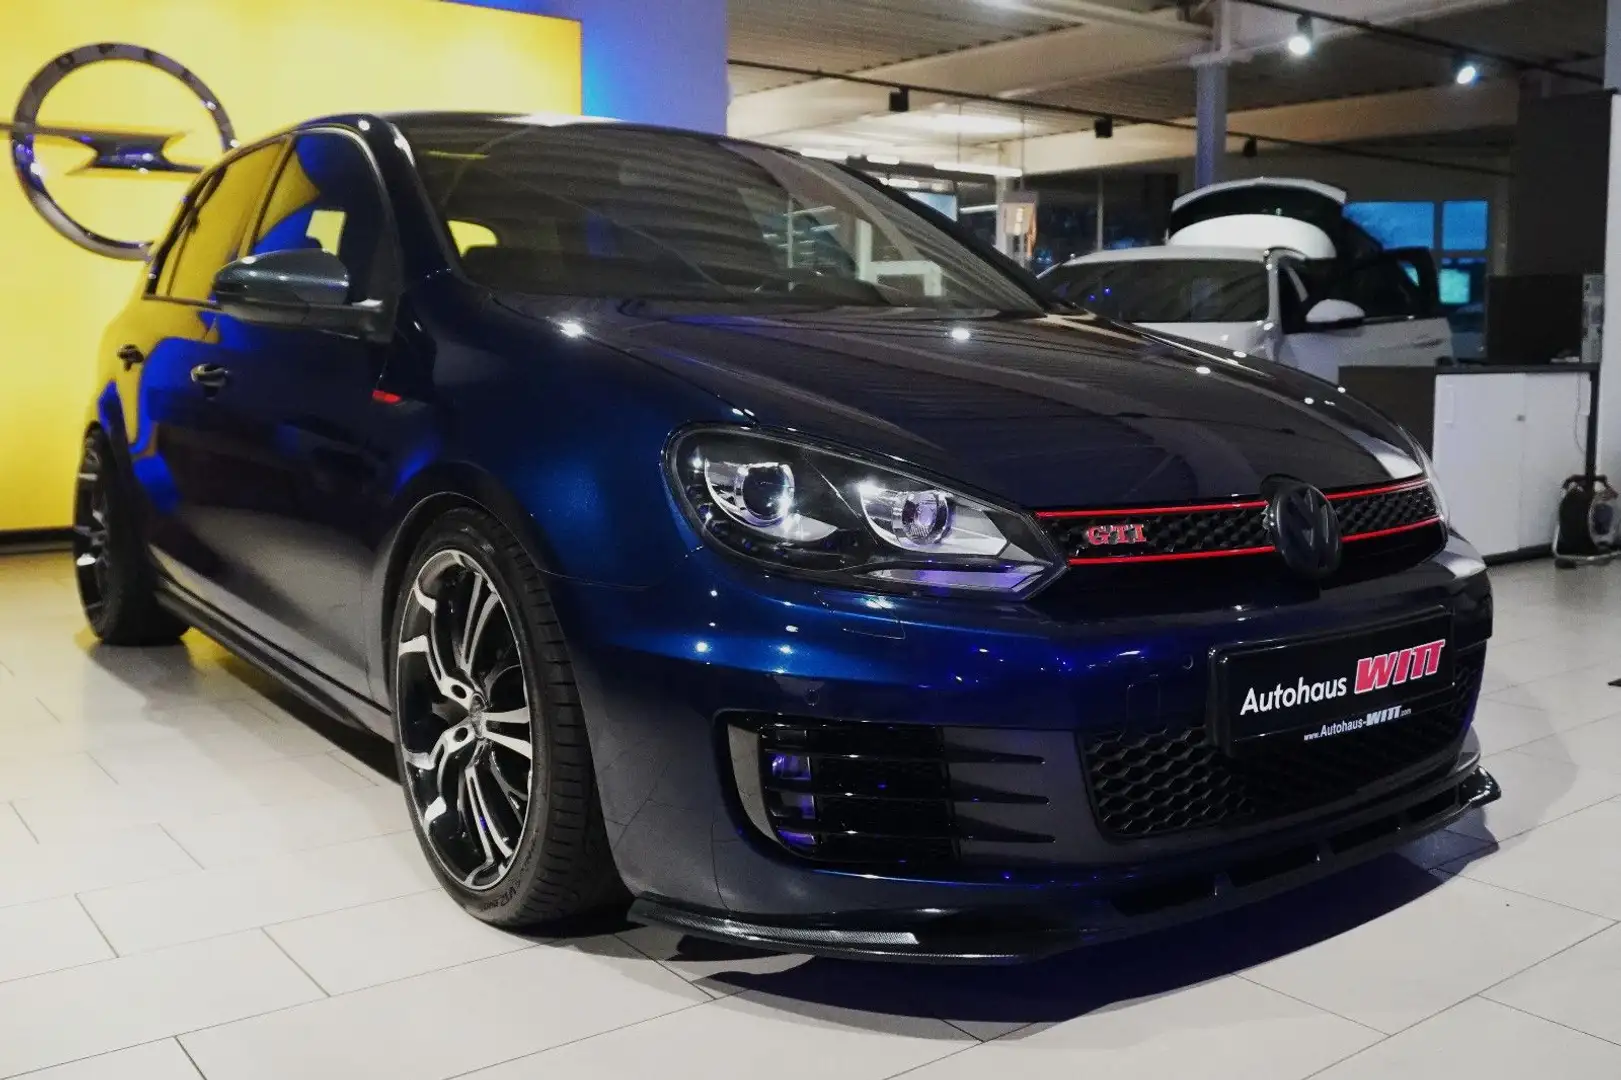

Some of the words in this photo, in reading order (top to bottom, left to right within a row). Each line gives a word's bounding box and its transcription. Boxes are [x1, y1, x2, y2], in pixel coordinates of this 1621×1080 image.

[1086, 524, 1147, 545] GTI
[1240, 676, 1347, 715] Autohaus
[1354, 639, 1446, 694] WITT
